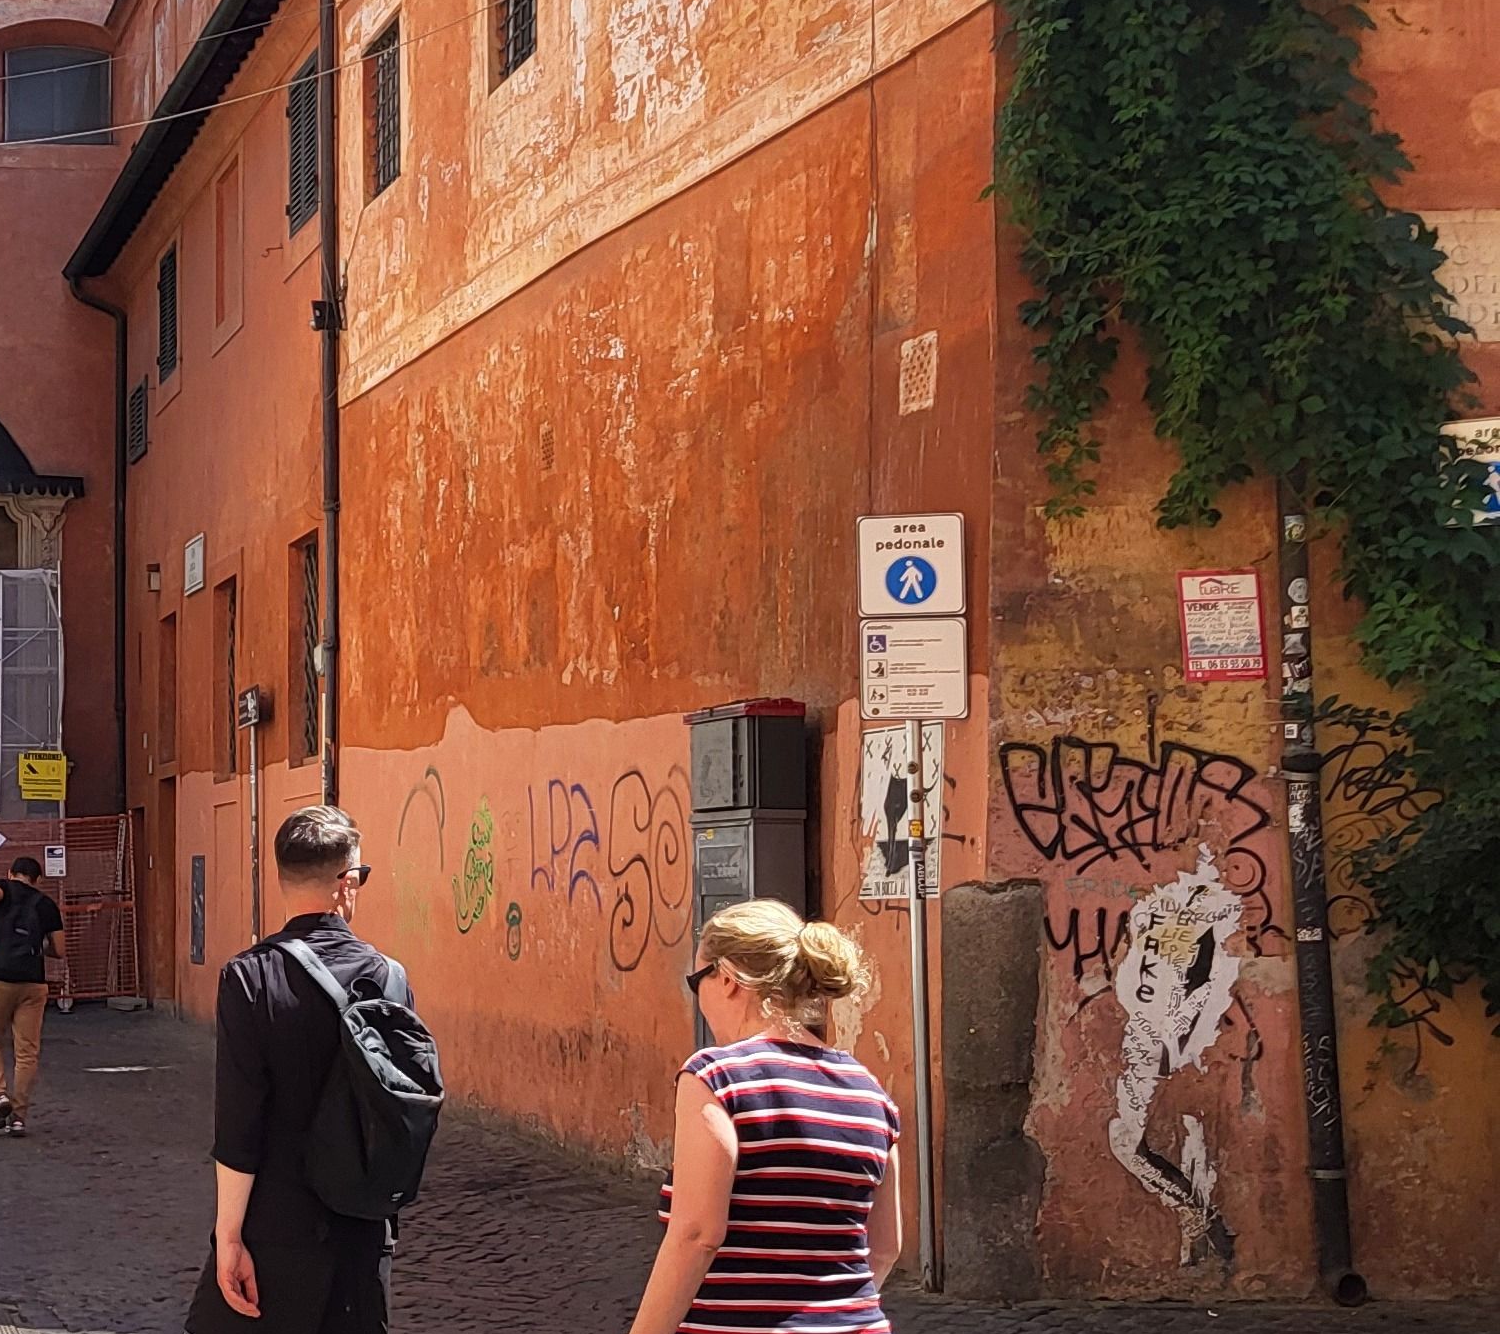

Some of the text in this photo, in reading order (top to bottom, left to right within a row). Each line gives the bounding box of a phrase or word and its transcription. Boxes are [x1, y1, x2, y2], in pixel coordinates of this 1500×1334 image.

[893, 523, 926, 533] area
[876, 537, 945, 552] pedonale
[1186, 602, 1220, 612] VENDE
